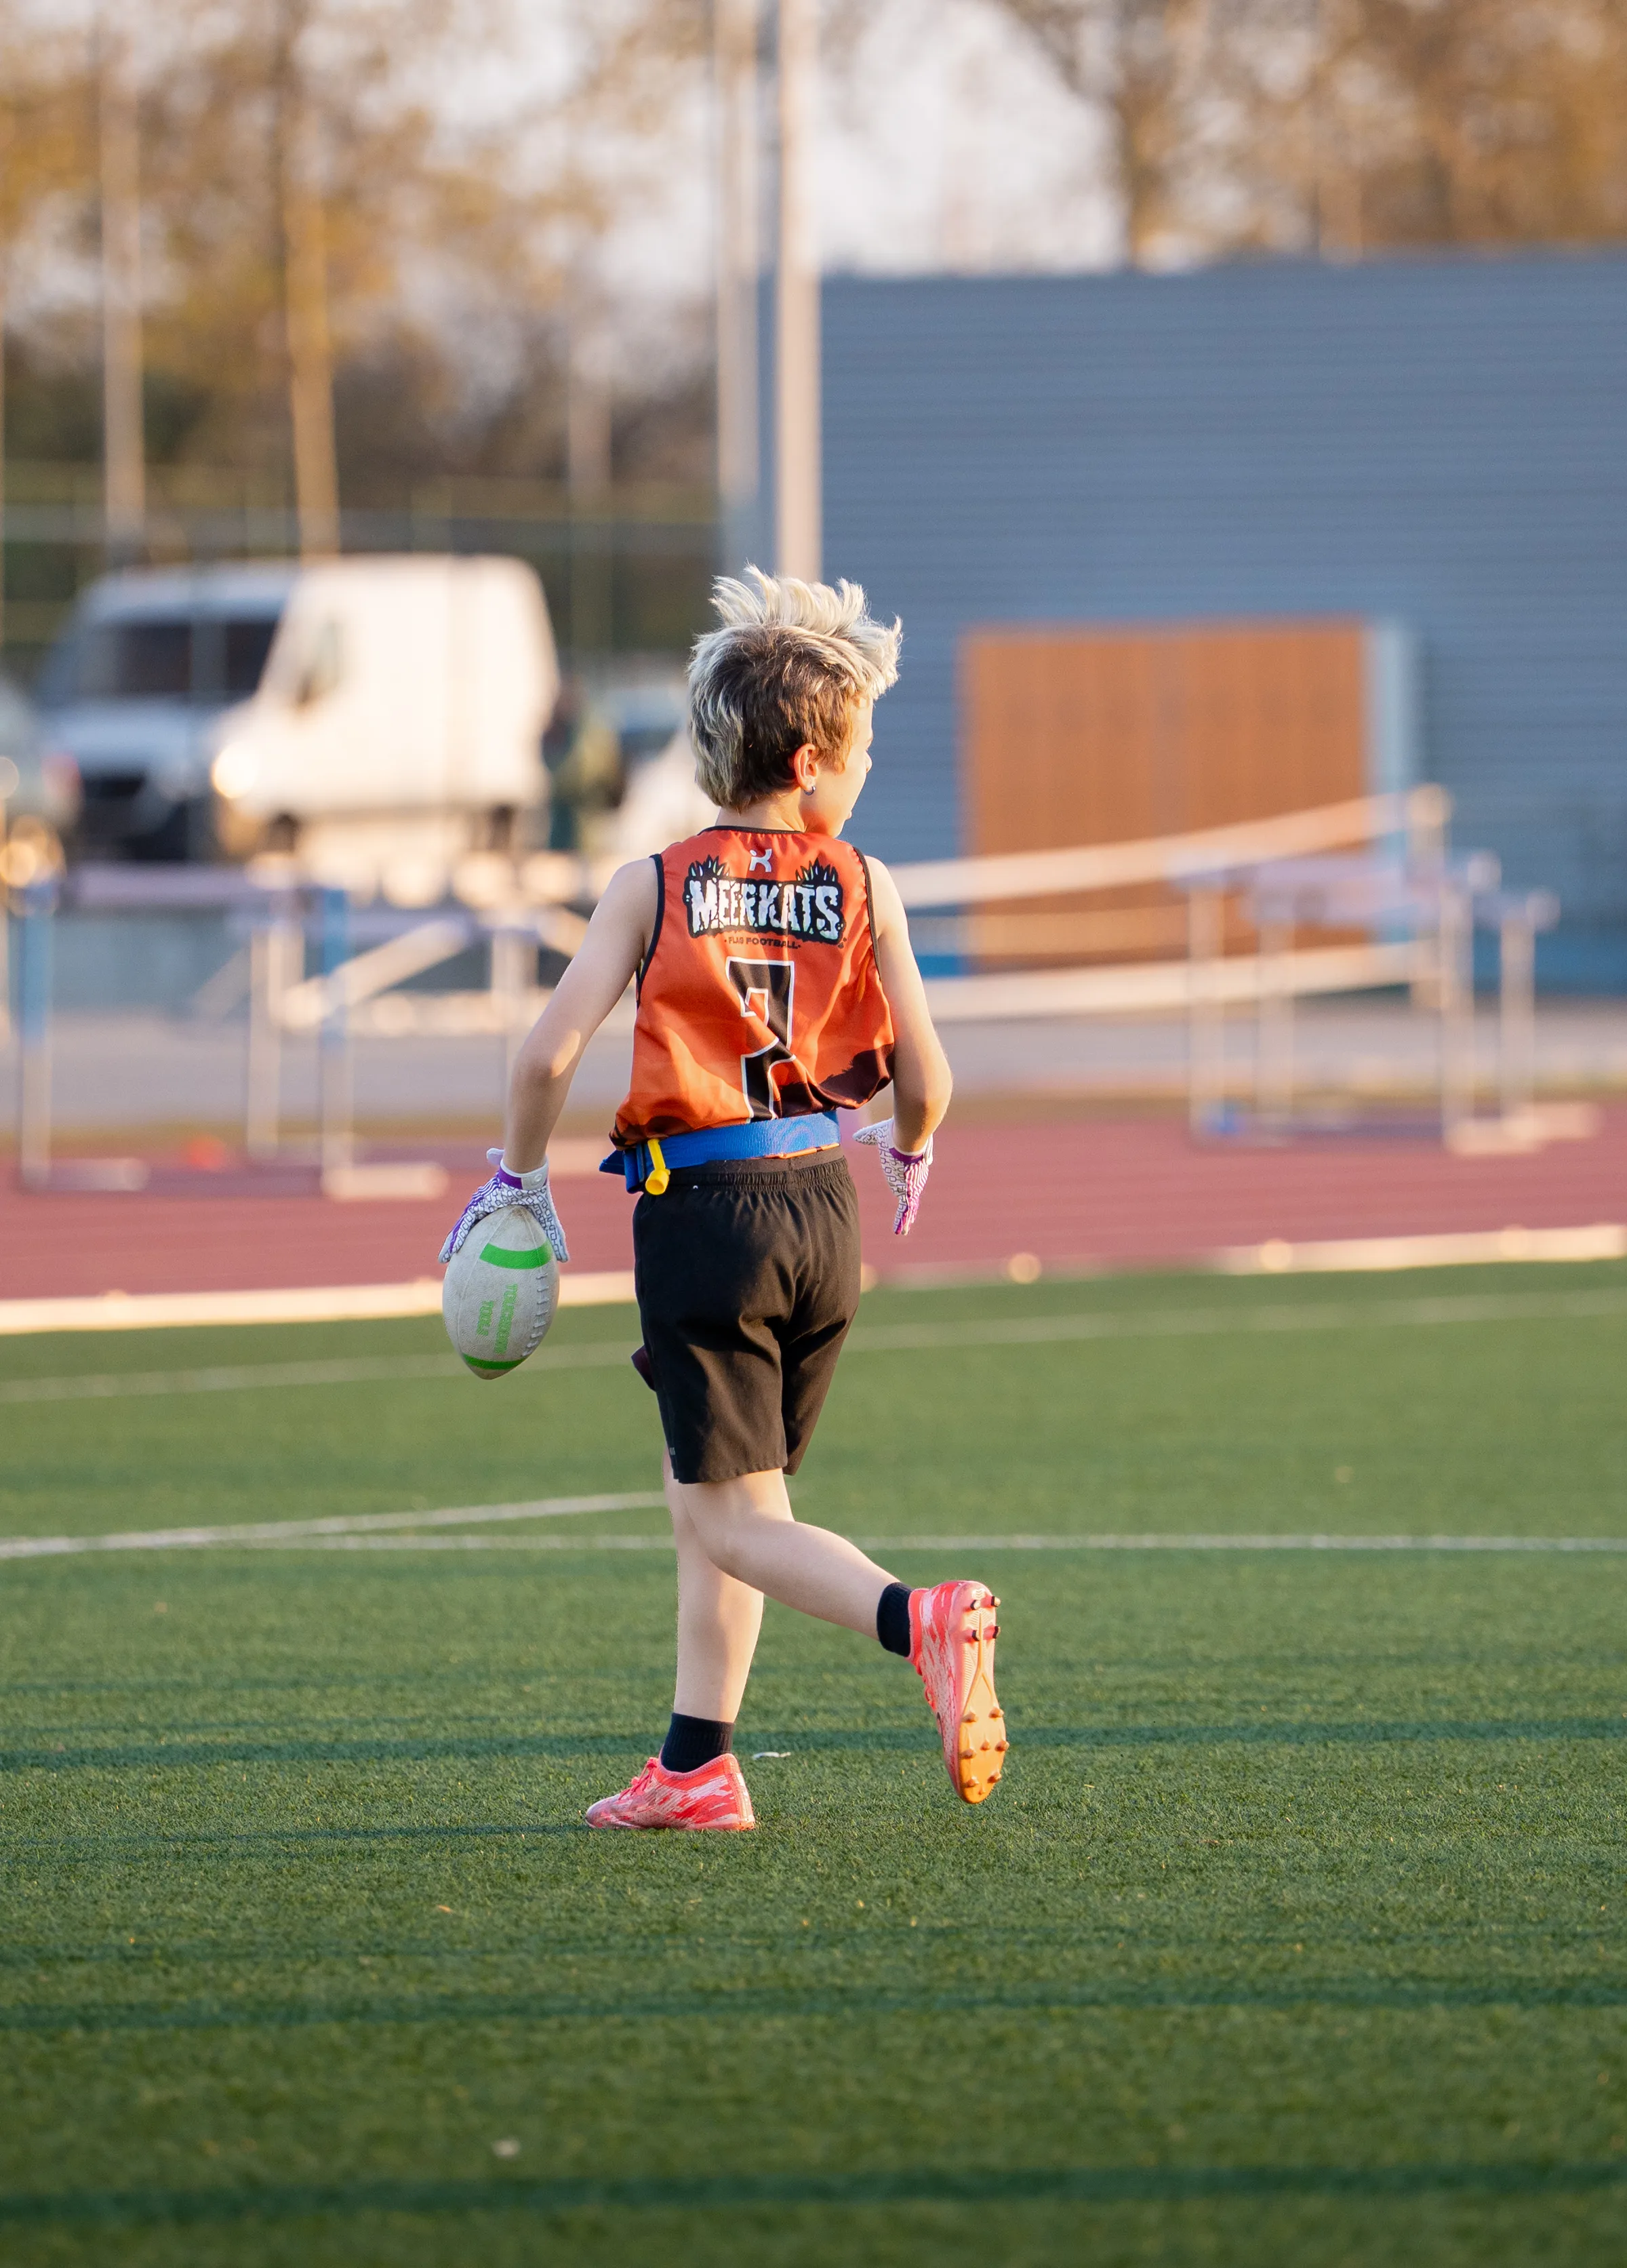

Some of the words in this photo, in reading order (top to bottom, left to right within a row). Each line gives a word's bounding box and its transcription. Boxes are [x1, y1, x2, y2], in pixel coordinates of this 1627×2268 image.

[689, 879, 840, 940] MEERKATS
[728, 936, 744, 944] FLAG
[746, 937, 799, 949] FOOTBALL
[725, 956, 796, 1123] 7
